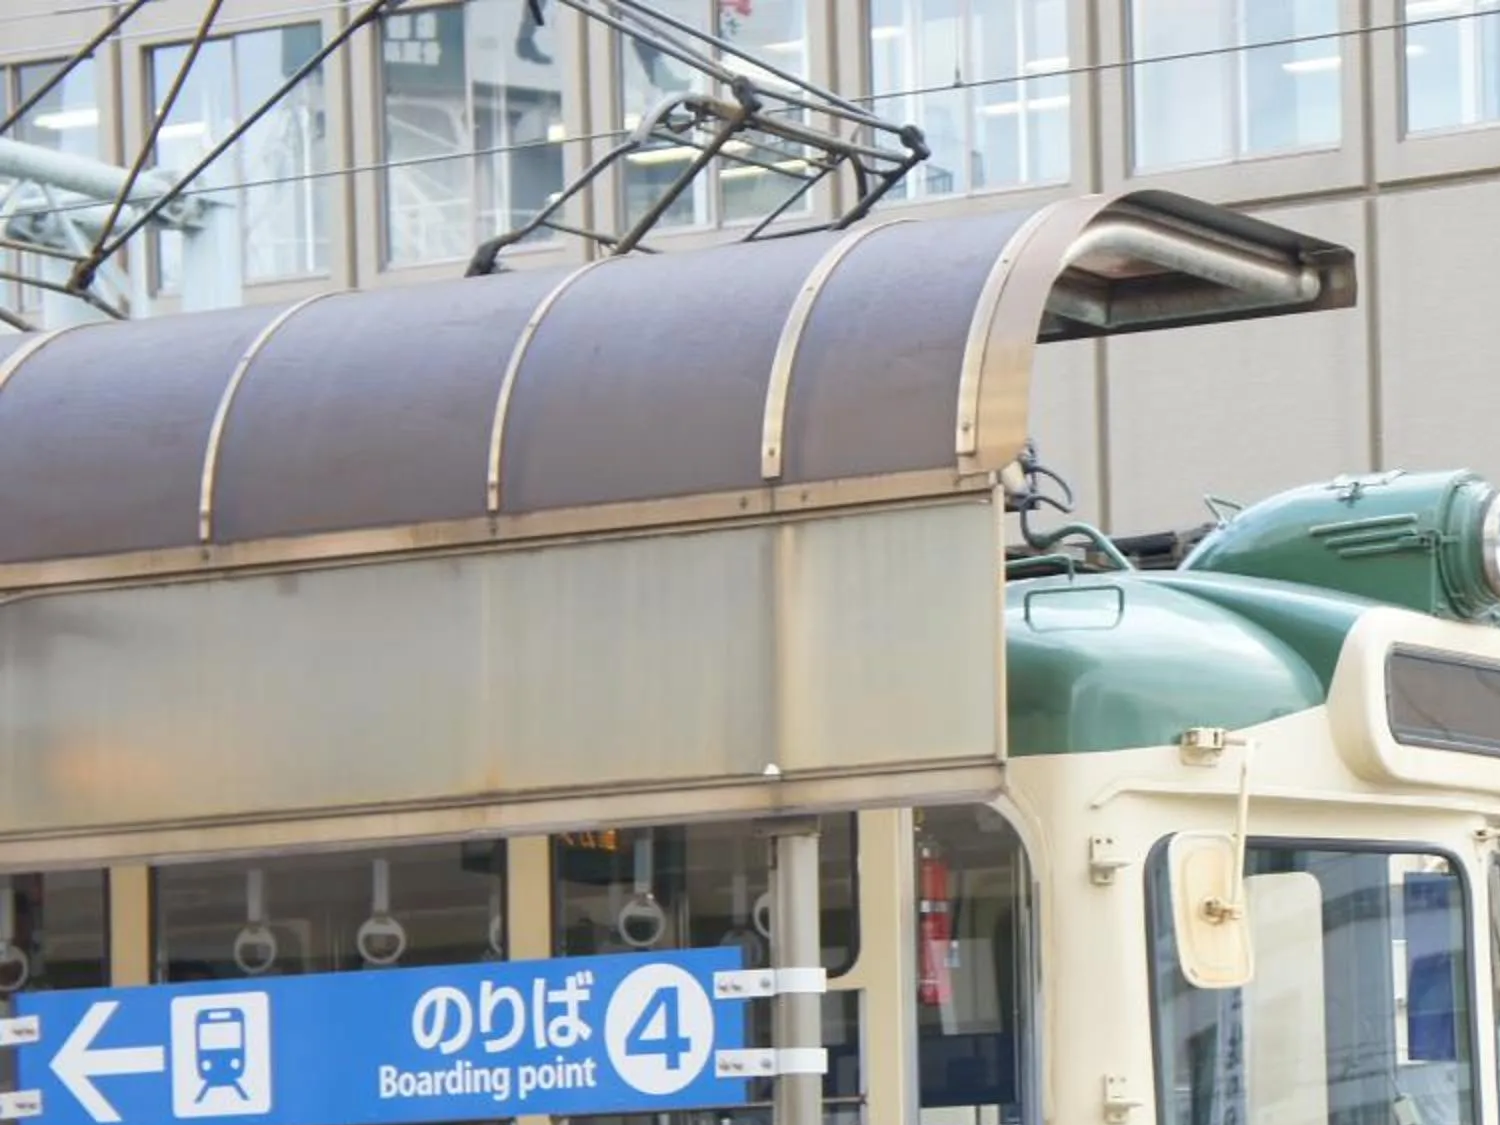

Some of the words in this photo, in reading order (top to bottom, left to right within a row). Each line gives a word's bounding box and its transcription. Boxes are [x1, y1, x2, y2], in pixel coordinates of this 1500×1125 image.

[412, 970, 594, 1056] のりば
[379, 1061, 511, 1101] Boarding
[518, 1056, 597, 1095] point
